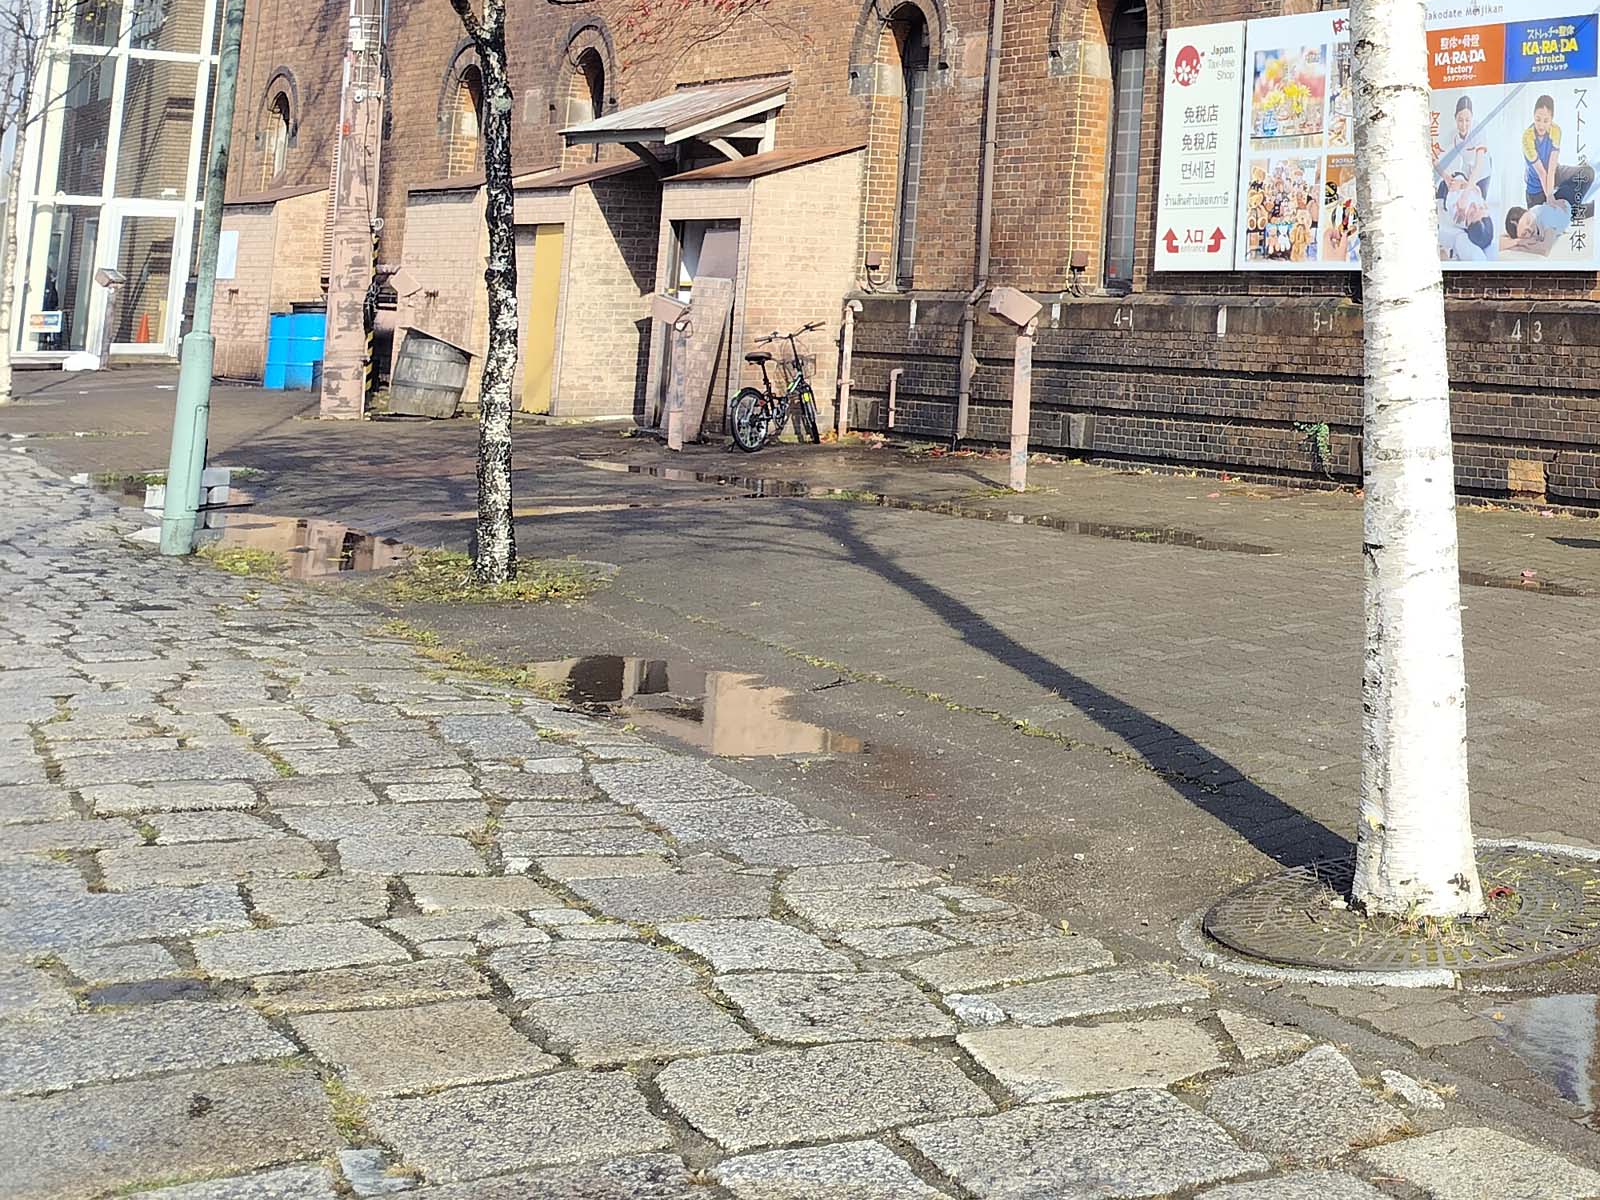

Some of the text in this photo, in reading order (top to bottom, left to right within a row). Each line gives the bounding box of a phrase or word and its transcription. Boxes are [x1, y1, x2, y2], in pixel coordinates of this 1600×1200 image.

[1535, 54, 1565, 64] stretch
[1217, 70, 1235, 81] Shop
[1446, 65, 1473, 75] factory
[1181, 160, 1215, 179] 면세점
[1184, 229, 1204, 244] 入口
